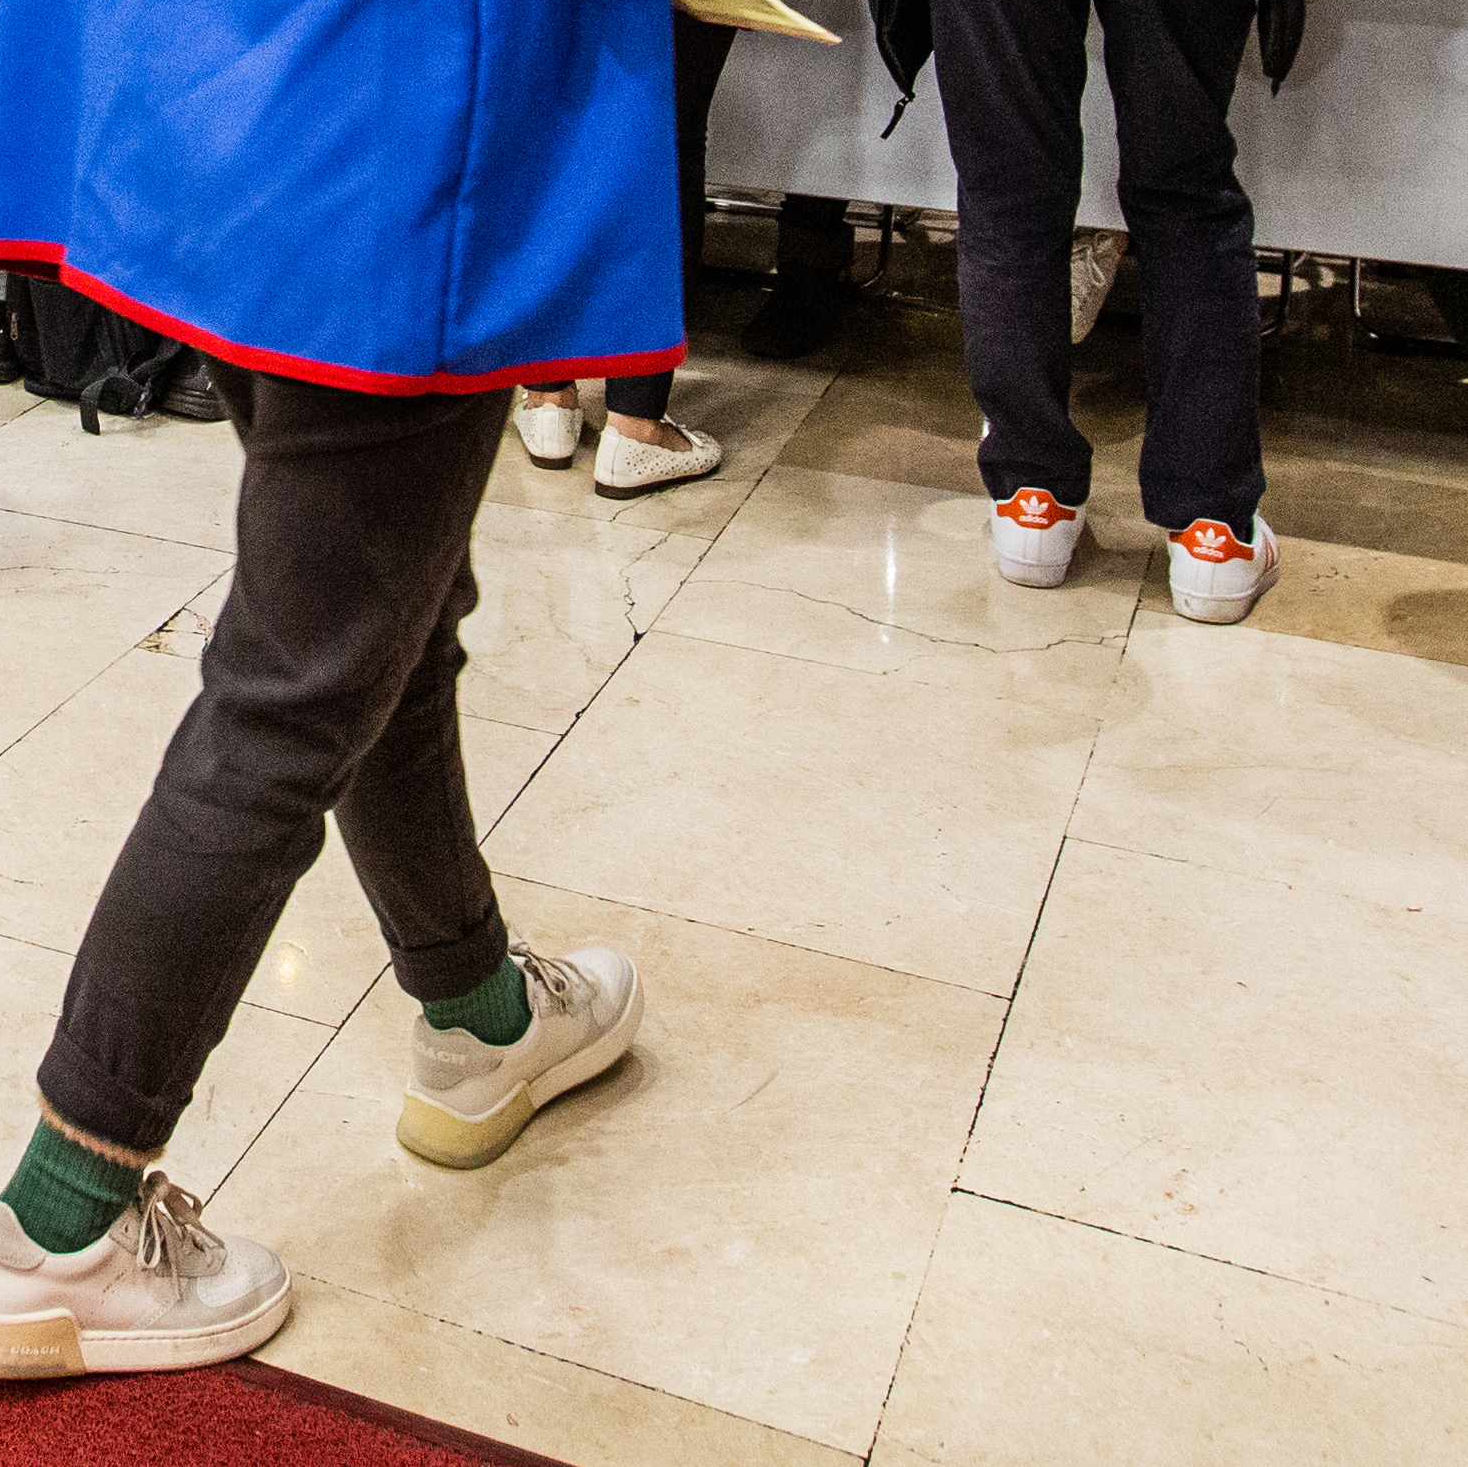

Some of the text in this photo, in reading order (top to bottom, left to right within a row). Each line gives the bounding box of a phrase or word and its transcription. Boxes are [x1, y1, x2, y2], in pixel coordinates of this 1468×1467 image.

[1018, 514, 1049, 525] adidas
[1193, 546, 1225, 559] adidas
[10, 1345, 61, 1355] COACH
